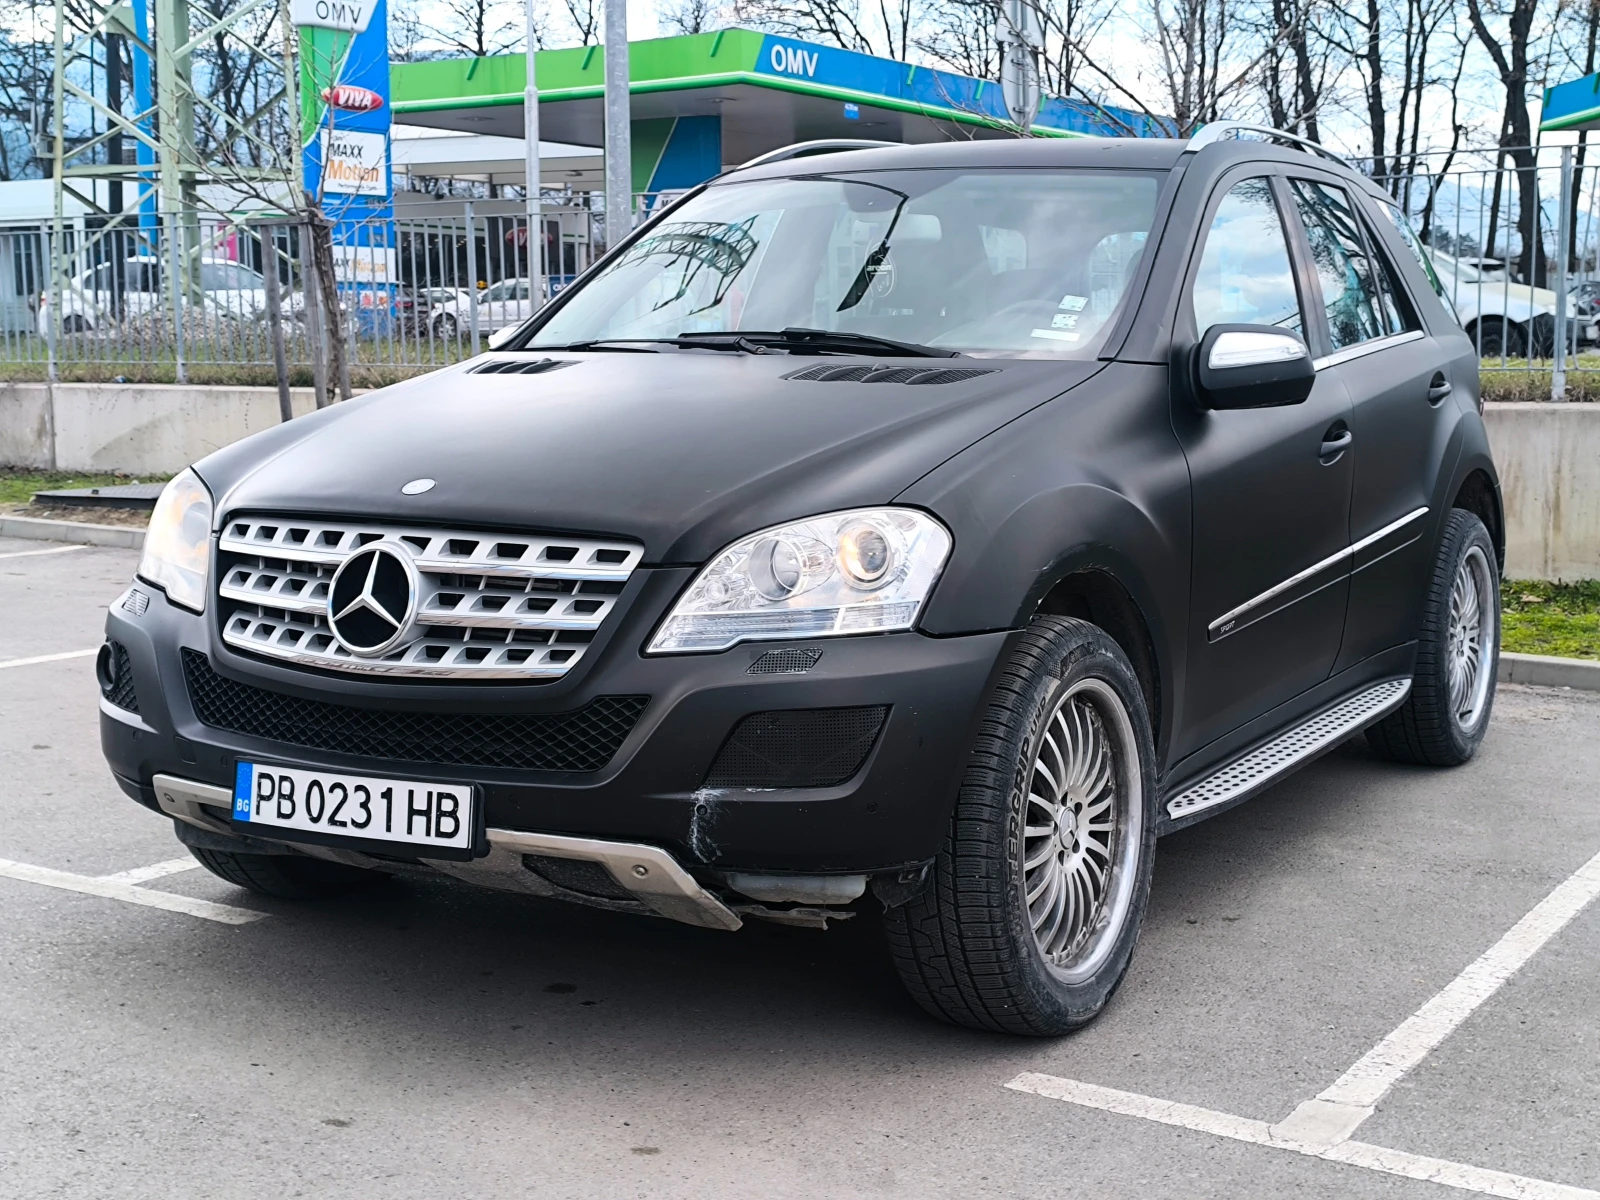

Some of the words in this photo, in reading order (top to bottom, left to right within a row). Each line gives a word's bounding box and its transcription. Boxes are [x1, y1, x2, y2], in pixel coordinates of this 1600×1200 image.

[316, 1, 361, 24] OMV
[770, 44, 819, 77] OMV
[338, 88, 372, 107] VIVA
[330, 143, 363, 158] MAXX
[328, 159, 379, 182] Motion
[1030, 696, 1046, 736] UHP
[236, 798, 249, 813] BG
[256, 772, 296, 820] PB
[305, 779, 393, 833] 0231
[406, 789, 461, 839] HB
